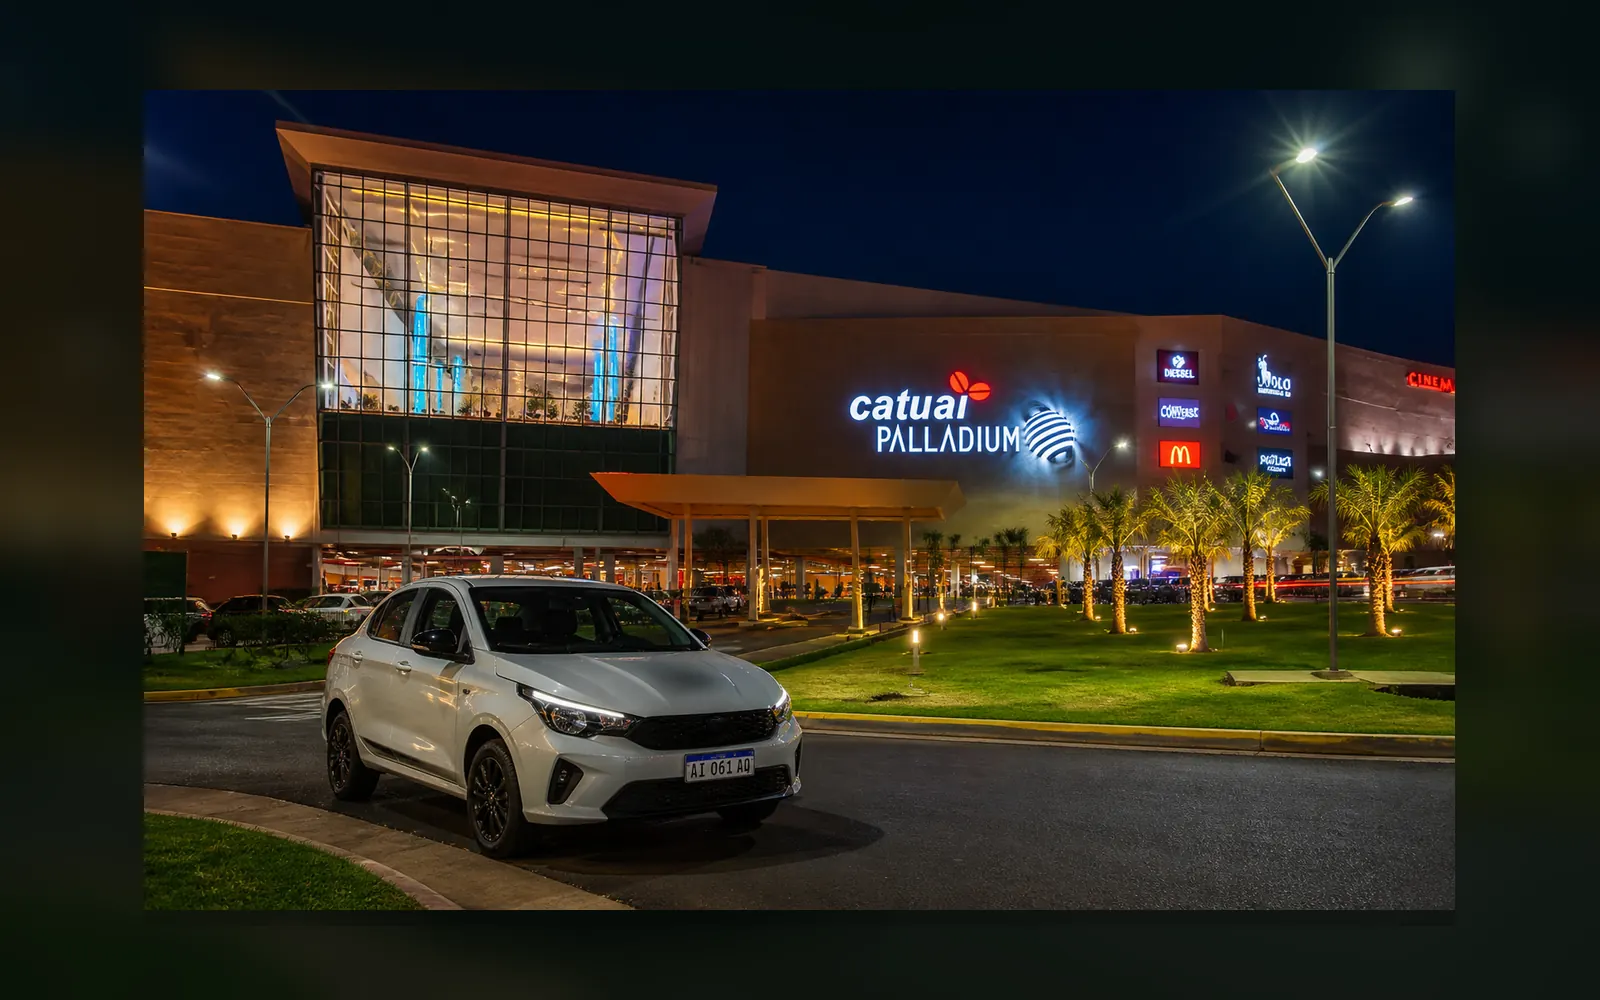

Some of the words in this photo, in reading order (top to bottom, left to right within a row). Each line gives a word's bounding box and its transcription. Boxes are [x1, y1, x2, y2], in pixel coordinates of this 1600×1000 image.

[877, 424, 1020, 452] PALLADIUM
[690, 763, 705, 778] AI
[710, 760, 733, 776] 061
